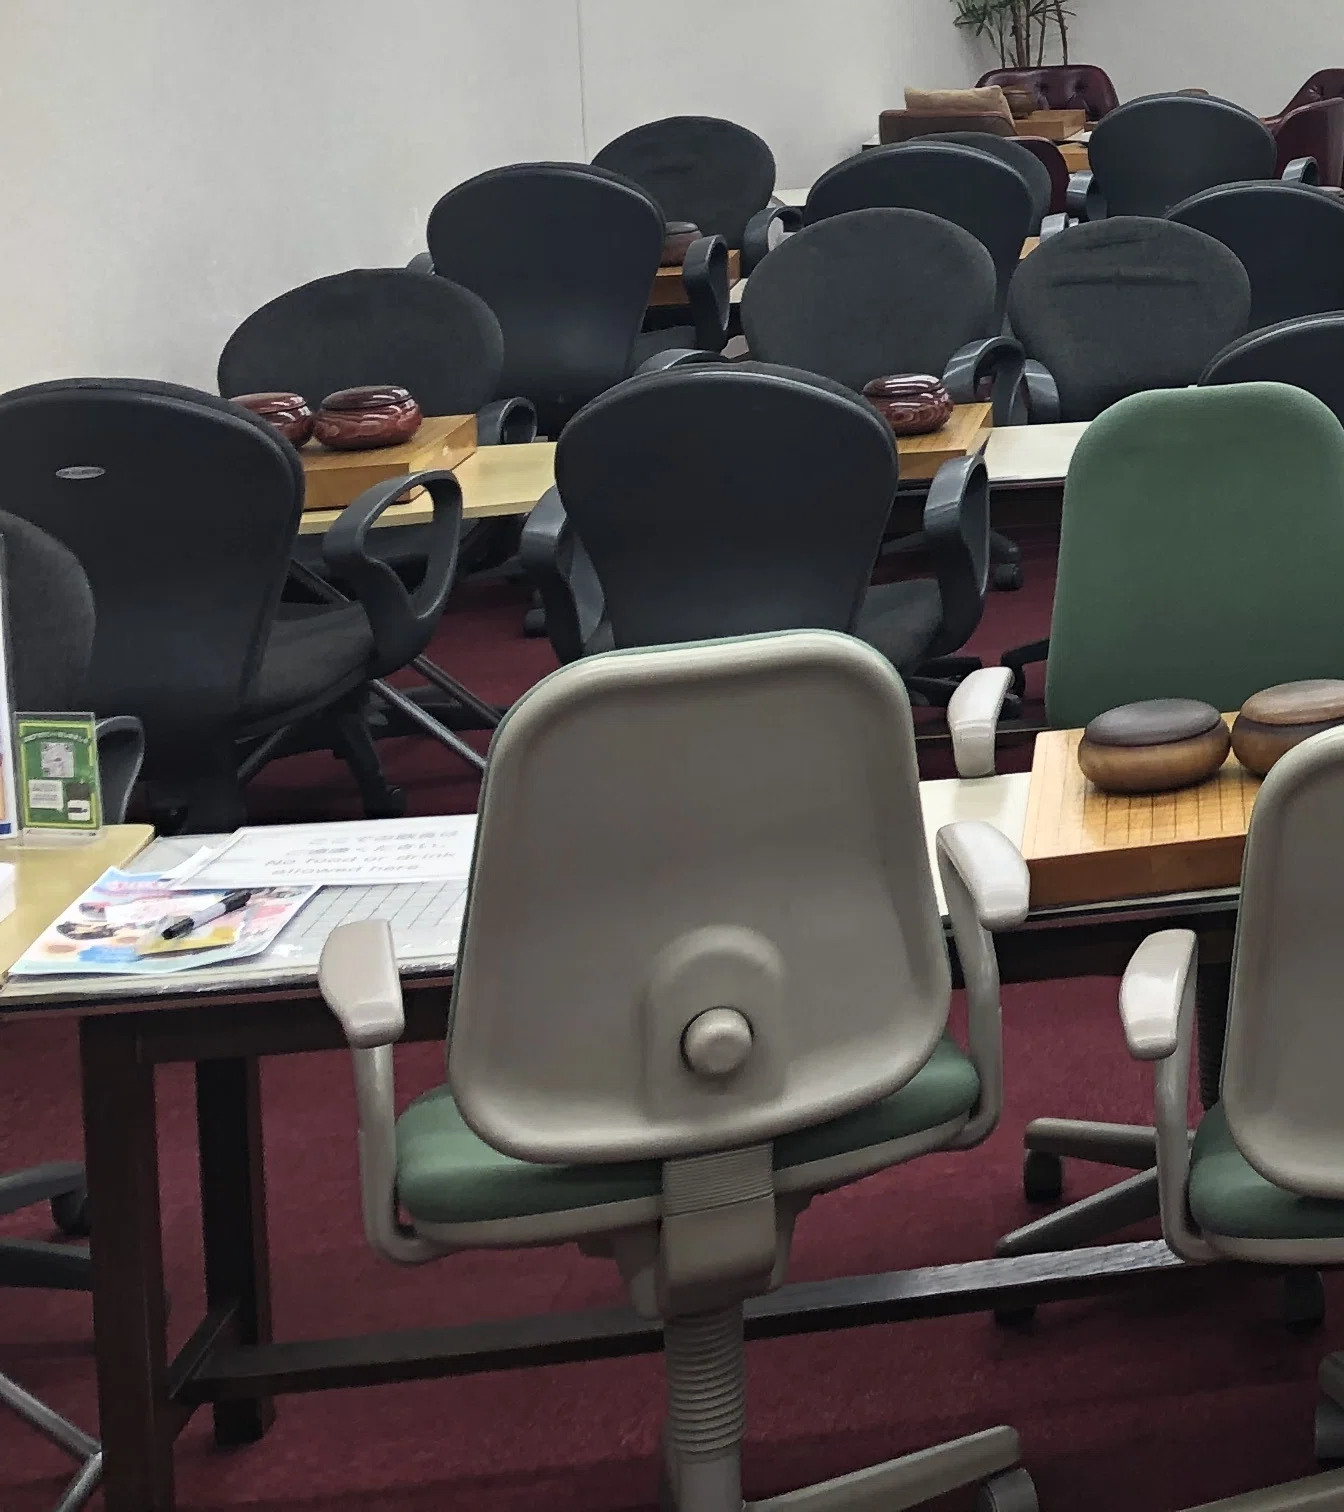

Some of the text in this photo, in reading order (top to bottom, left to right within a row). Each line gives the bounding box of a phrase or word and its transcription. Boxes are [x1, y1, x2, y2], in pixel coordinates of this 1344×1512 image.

[265, 859, 296, 867] No
[305, 855, 358, 864] food
[397, 852, 457, 861] drink
[271, 864, 419, 876] allowed here
